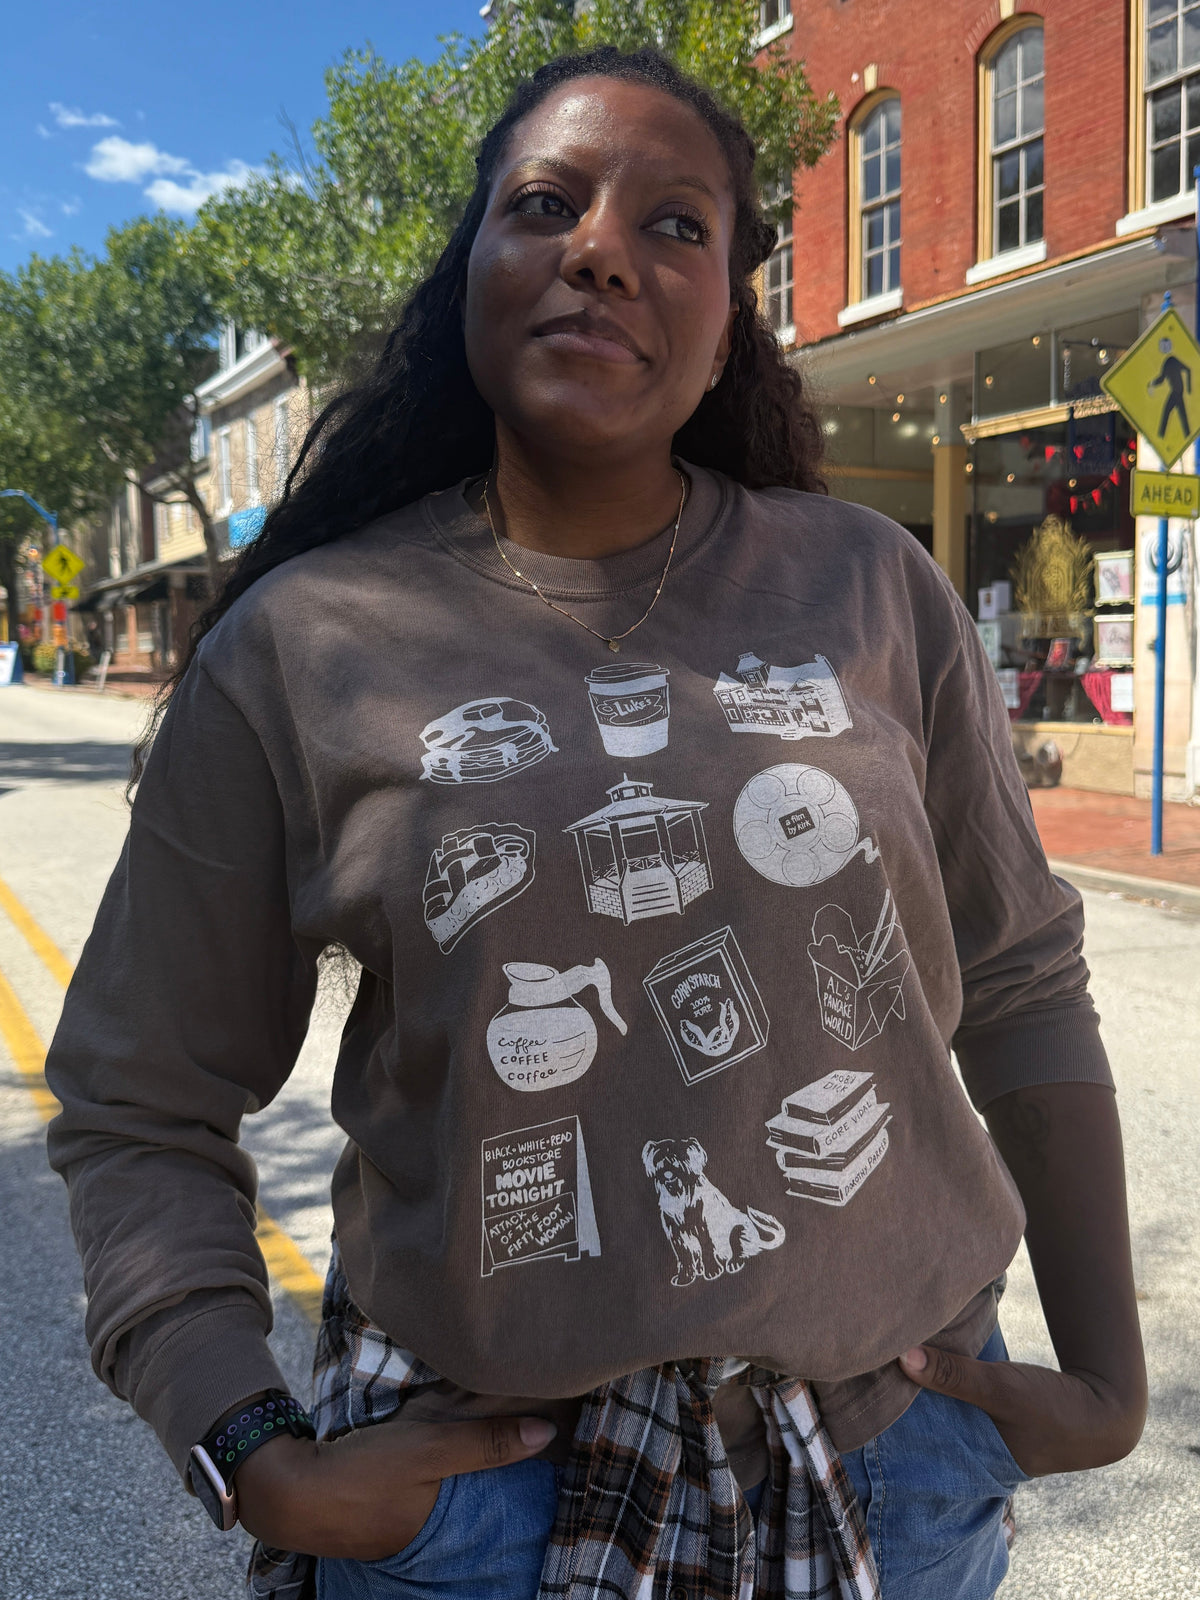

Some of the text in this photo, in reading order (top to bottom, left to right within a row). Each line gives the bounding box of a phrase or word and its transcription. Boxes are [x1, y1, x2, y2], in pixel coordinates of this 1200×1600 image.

[1141, 484, 1193, 506] AHEAD
[787, 825, 797, 836] by
[791, 813, 806, 823] film
[693, 1003, 713, 1018] PURE
[823, 992, 853, 1019] PANCAKE
[824, 1011, 853, 1040] WORLD
[500, 1051, 549, 1066] COFFEE
[823, 1081, 849, 1093] DICK
[830, 1073, 857, 1085] MOBY
[825, 1101, 873, 1146] GORE VIDAL
[517, 1138, 547, 1154] WHITE
[550, 1131, 573, 1147] READ
[502, 1148, 562, 1171] BOOKSTORE
[495, 1161, 556, 1191] MOVIE
[485, 1179, 565, 1208] TONIGHT
[489, 1211, 527, 1239] ATTACK
[500, 1211, 539, 1245] OF THE
[507, 1202, 563, 1257] FIFTY FOOT
[534, 1211, 574, 1247] WOMAN
